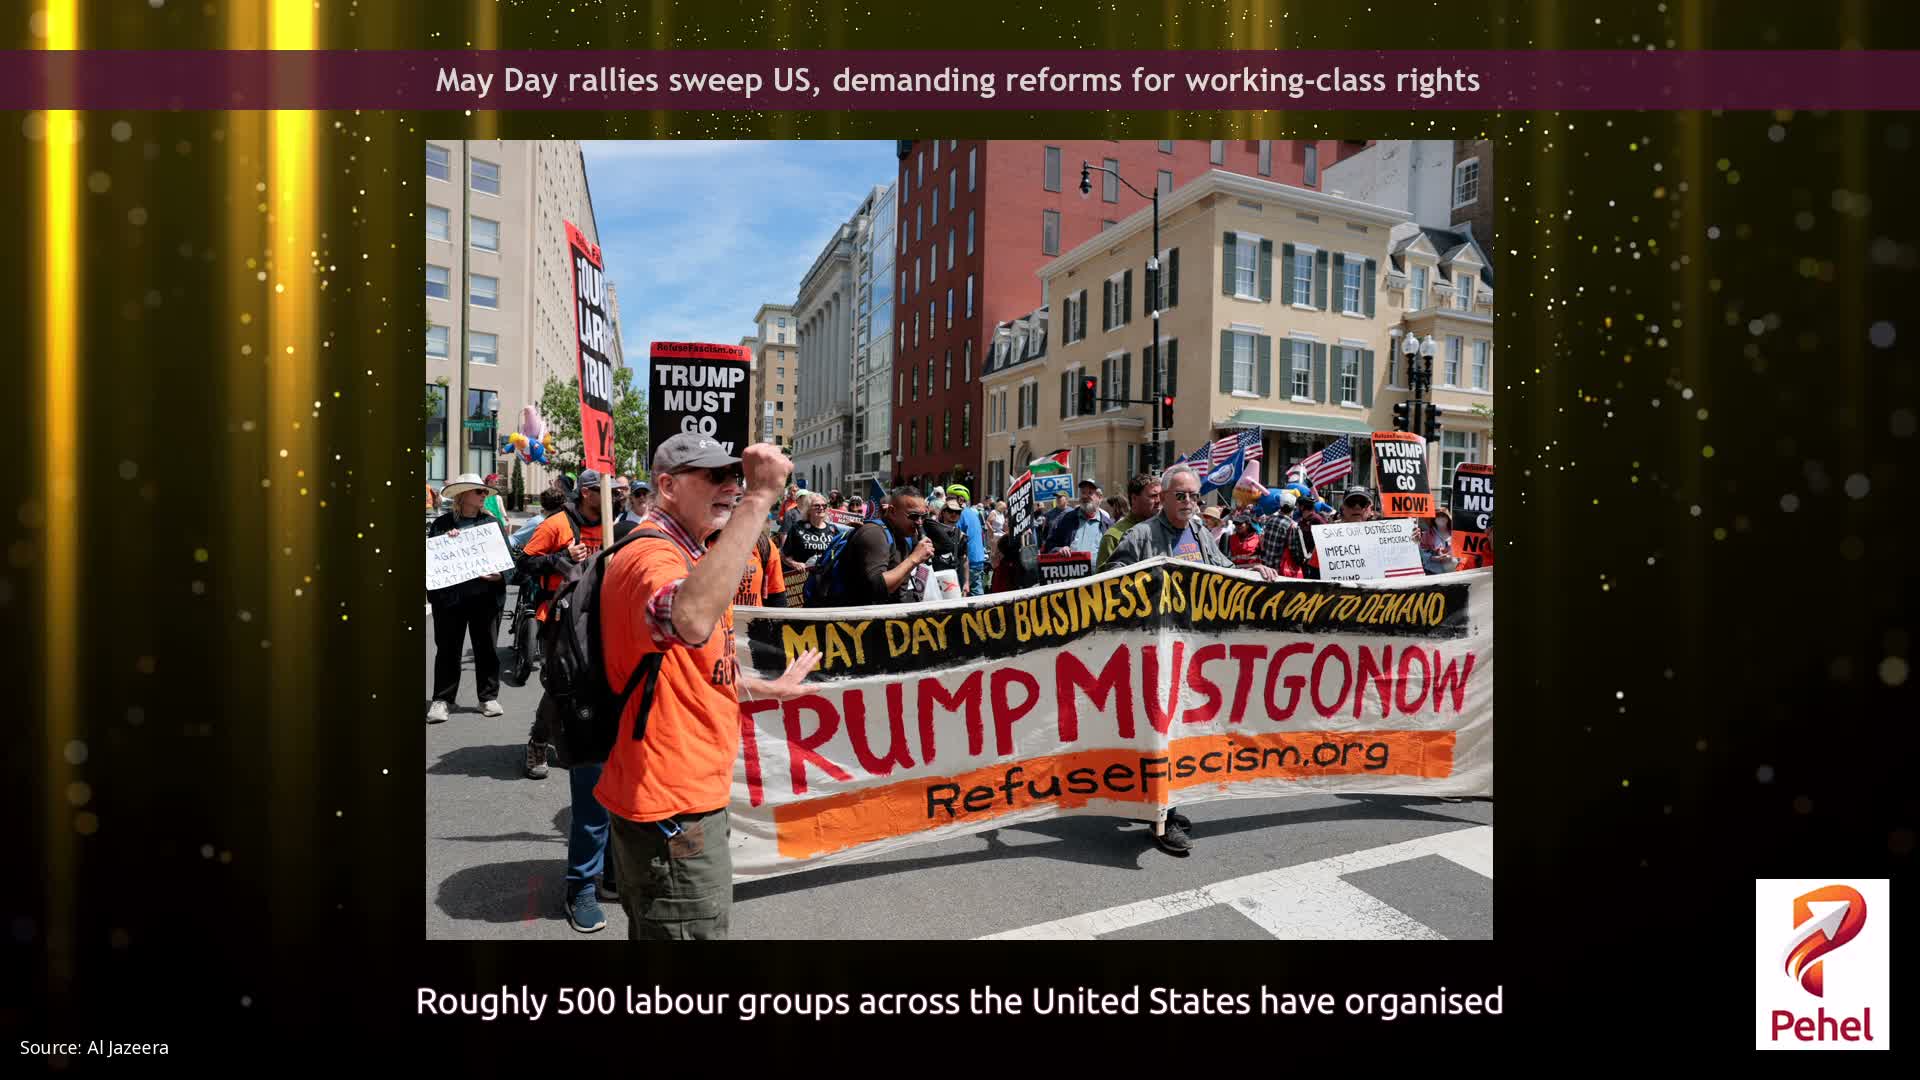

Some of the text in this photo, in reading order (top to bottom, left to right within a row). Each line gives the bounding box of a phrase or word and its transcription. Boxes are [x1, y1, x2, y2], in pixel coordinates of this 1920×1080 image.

[656, 342, 744, 356] RefuseFascism.org
[582, 351, 611, 401] TRU
[655, 364, 745, 388] TRUMP
[664, 390, 736, 413] MUST
[681, 415, 718, 437] GO
[597, 419, 612, 457] Y
[1374, 442, 1422, 458] TRUMP
[1382, 458, 1421, 475] MUST
[1034, 477, 1071, 493] NOPE
[1396, 475, 1416, 491] GO
[1008, 481, 1032, 506] TRUMP
[1011, 494, 1030, 517] MUST
[1391, 496, 1428, 512] NOW!
[1463, 495, 1493, 512] MU
[1016, 508, 1026, 523] GO
[1364, 524, 1402, 535] DISTRESSED
[434, 542, 487, 561] AGAINST
[1324, 544, 1361, 557] IMPEACH
[430, 557, 490, 576] HRISTIAN
[1040, 563, 1089, 579] TRUMP
[1328, 558, 1367, 571] DICTATOR
[781, 620, 870, 672] MAY
[885, 614, 952, 658] DAY
[961, 605, 1007, 645] NO
[1013, 571, 1152, 643] BUSINESS
[1159, 568, 1186, 615] AS
[1190, 571, 1266, 622] USUAL
[1260, 591, 1278, 620] A
[1284, 591, 1335, 623] DAY
[1330, 594, 1361, 620] TO
[1358, 591, 1446, 627] DEMAND
[738, 667, 1040, 808] TRUMP
